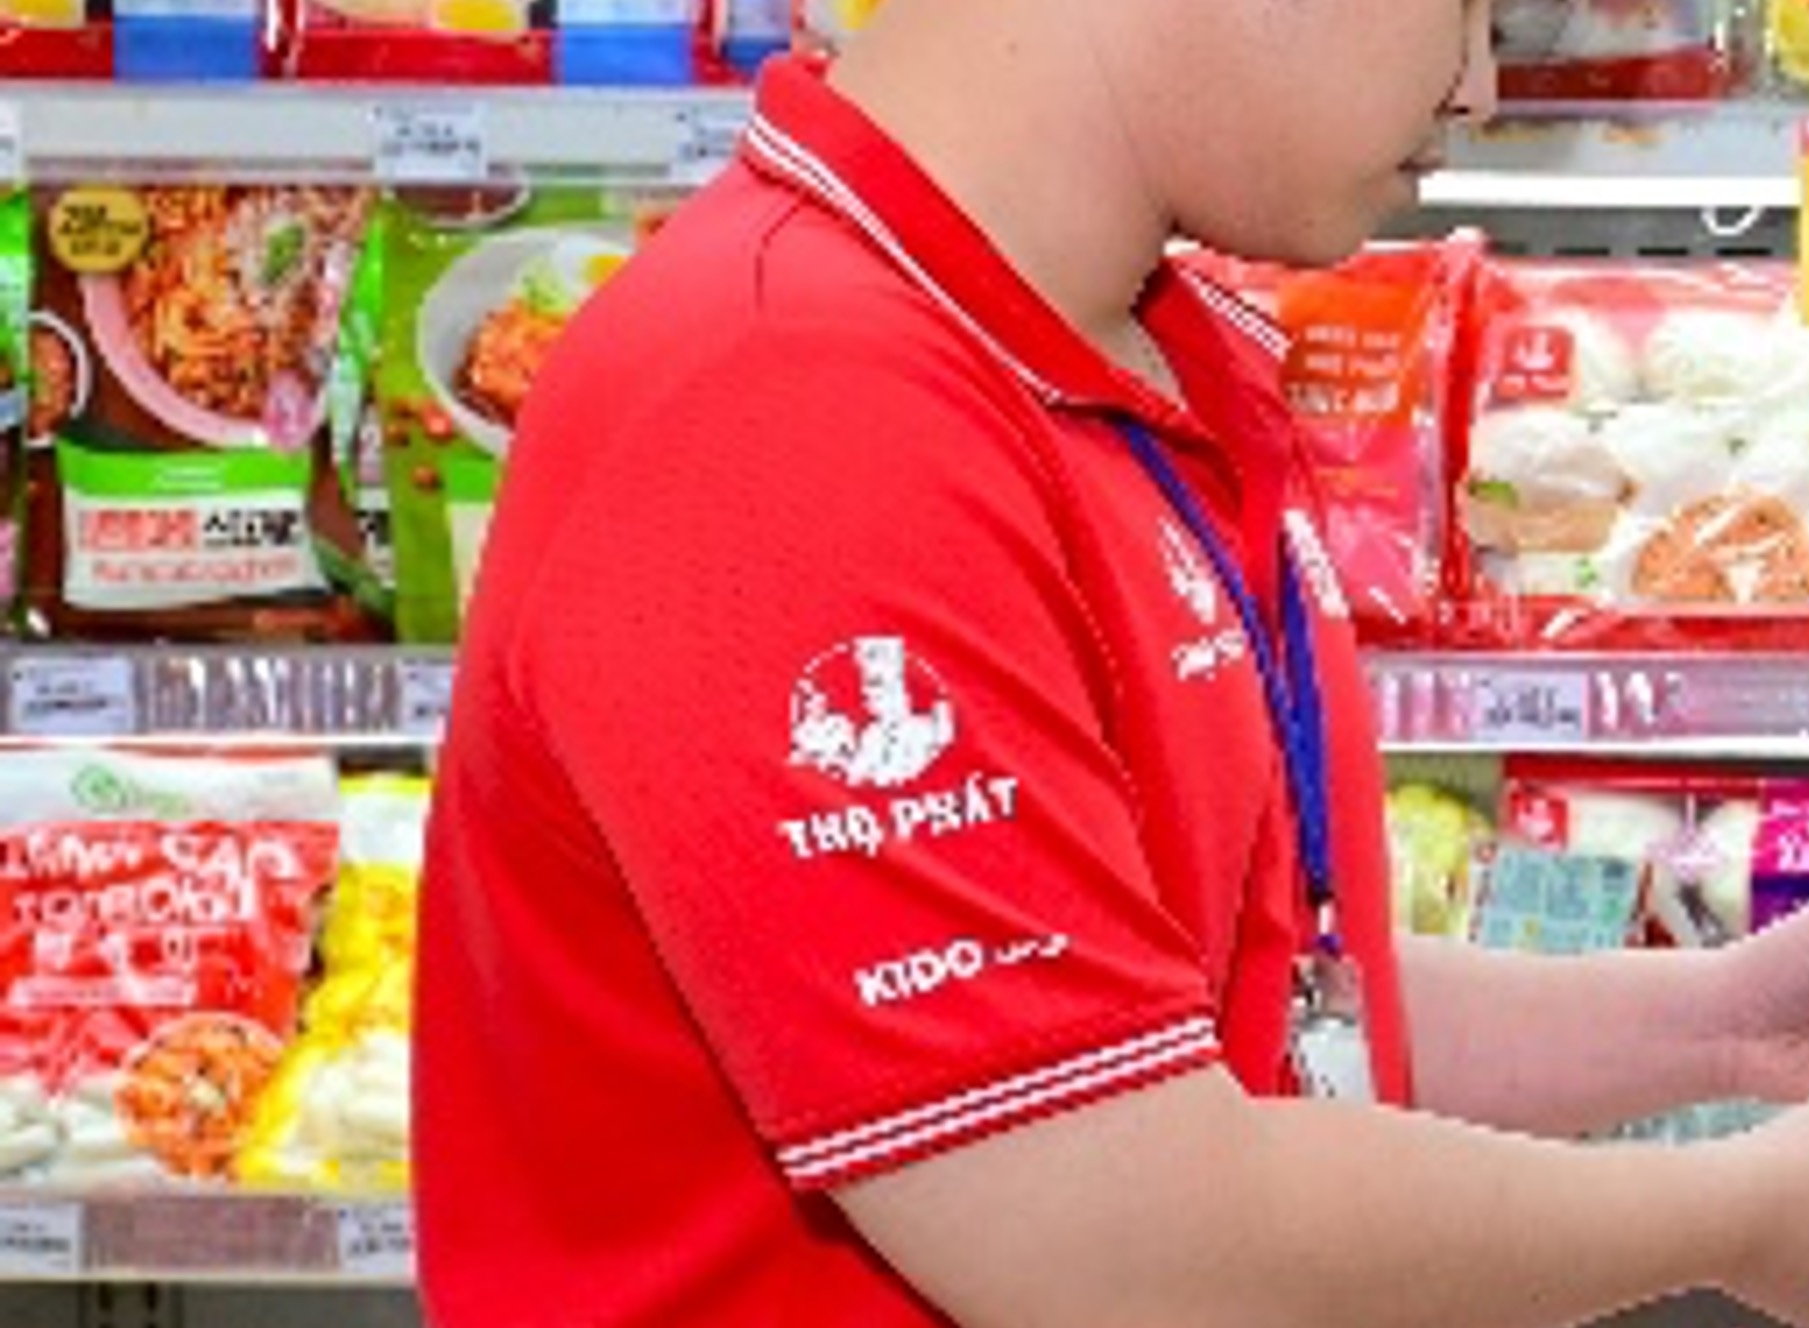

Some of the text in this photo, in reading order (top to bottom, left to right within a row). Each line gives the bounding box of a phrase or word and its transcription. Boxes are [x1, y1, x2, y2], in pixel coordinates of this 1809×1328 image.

[778, 770, 1019, 859] THỌ PHÁT
[853, 937, 984, 1007] KIDO
